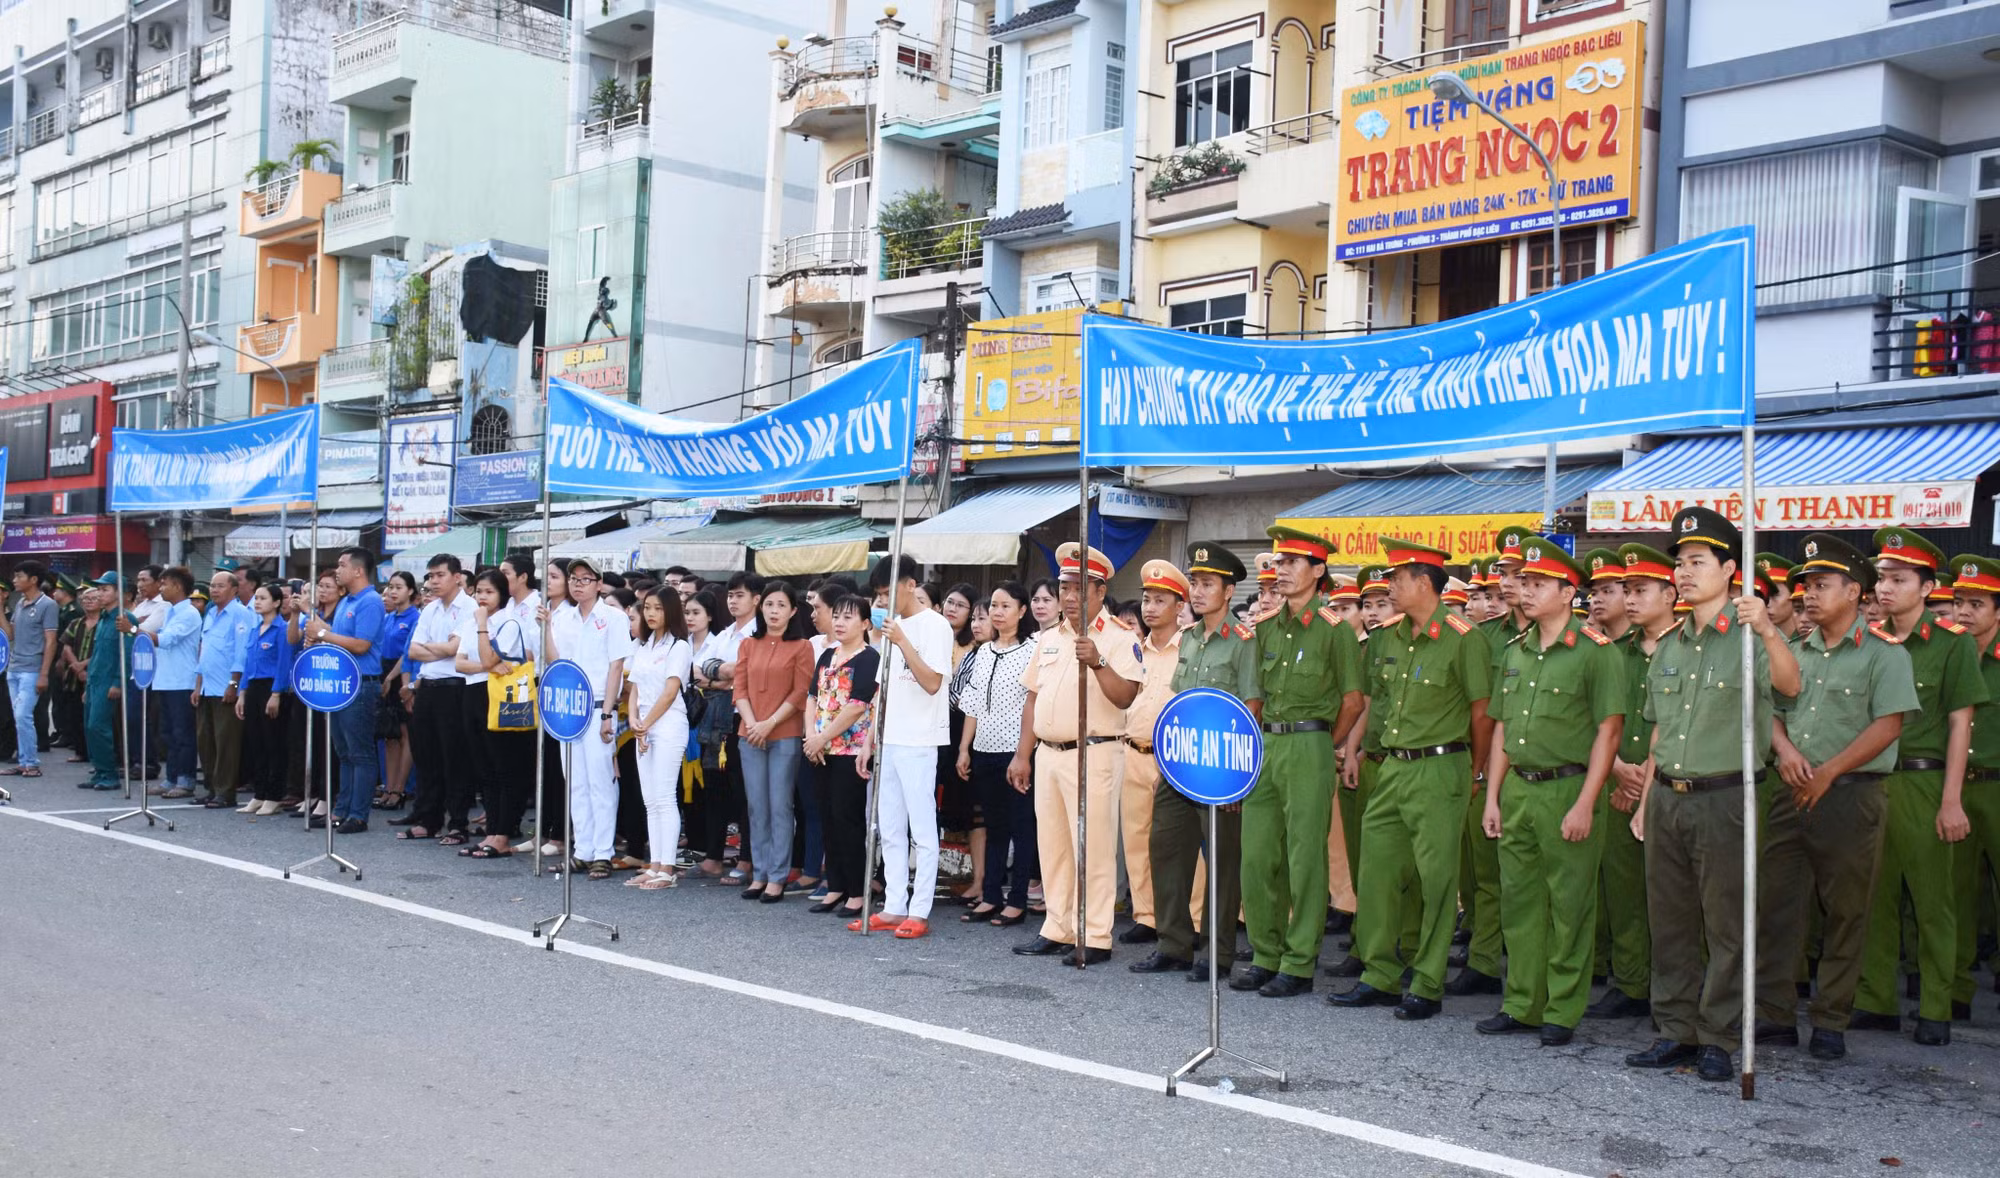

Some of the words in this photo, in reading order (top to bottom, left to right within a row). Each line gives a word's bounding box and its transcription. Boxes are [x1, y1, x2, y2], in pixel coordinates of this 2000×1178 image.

[1378, 85, 1389, 100] TY
[1505, 51, 1540, 72] TRANG
[1541, 43, 1571, 64] NGỌC
[1573, 37, 1595, 57] BẠC
[1598, 30, 1622, 50] LIÊU
[1405, 95, 1469, 131] TIỆM
[1478, 75, 1556, 116] VÀNG
[1347, 135, 1467, 203] TRANG
[1475, 109, 1592, 181] NGỌC
[1598, 104, 1621, 158] 2
[1347, 211, 1390, 235] CHUYÊN
[1393, 208, 1417, 228] MUA
[1422, 202, 1445, 223] BÁN
[1449, 196, 1479, 217] VÀNG
[1483, 192, 1506, 213] 24K
[1517, 187, 1538, 207] 17K
[1572, 174, 1614, 198] TRANG
[1366, 243, 1376, 253] HAI
[1440, 229, 1460, 242] THÀNH
[1473, 225, 1486, 238] BẠC
[1486, 222, 1500, 235] LIÊU
[1100, 350, 1130, 426] HÃY
[1133, 366, 1188, 426] CHUNG
[1188, 368, 1228, 425] TAY
[1224, 355, 1275, 425] BẢO
[1265, 361, 1311, 441] VỆ
[1297, 354, 1357, 422] THẾ
[1339, 358, 1390, 438] HỆ
[1376, 345, 1432, 416] TRẺ
[1422, 330, 1490, 412] KHỎI
[1483, 309, 1553, 405] HIỂM
[1552, 317, 1611, 415] HỌA
[1613, 312, 1651, 388] MA
[1662, 282, 1713, 382] TÚY
[60, 408, 82, 435] BÁN
[549, 406, 601, 470] TUỔI
[604, 418, 645, 473] TRẺ
[638, 427, 676, 477] NÓI
[671, 429, 762, 477] KHÔNG
[749, 414, 803, 470] VỚI
[802, 413, 840, 463] MA
[844, 391, 895, 455] TÚY
[50, 440, 68, 468] TRẢ
[67, 440, 89, 466] GÓP
[480, 456, 527, 476] PASSION
[1621, 494, 1685, 523] LÂM
[1695, 492, 1767, 522] IÊN
[1776, 494, 1896, 526] THẠNH
[1903, 503, 1923, 518] 0947
[1925, 501, 1942, 518] 234
[1944, 501, 1962, 517] 010
[1345, 521, 1379, 556] CẦM
[1428, 524, 1453, 556] LÃI
[1457, 521, 1501, 555] SUẤT
[299, 677, 313, 692] CAO
[334, 679, 340, 694] Y
[341, 675, 352, 694] TẾ
[543, 686, 554, 713] TP.
[555, 687, 569, 719] BẠC
[570, 682, 588, 717] LIÊU
[1163, 715, 1198, 766] CÔNG
[1201, 729, 1220, 768] AN
[1223, 718, 1253, 773] TỈNH
